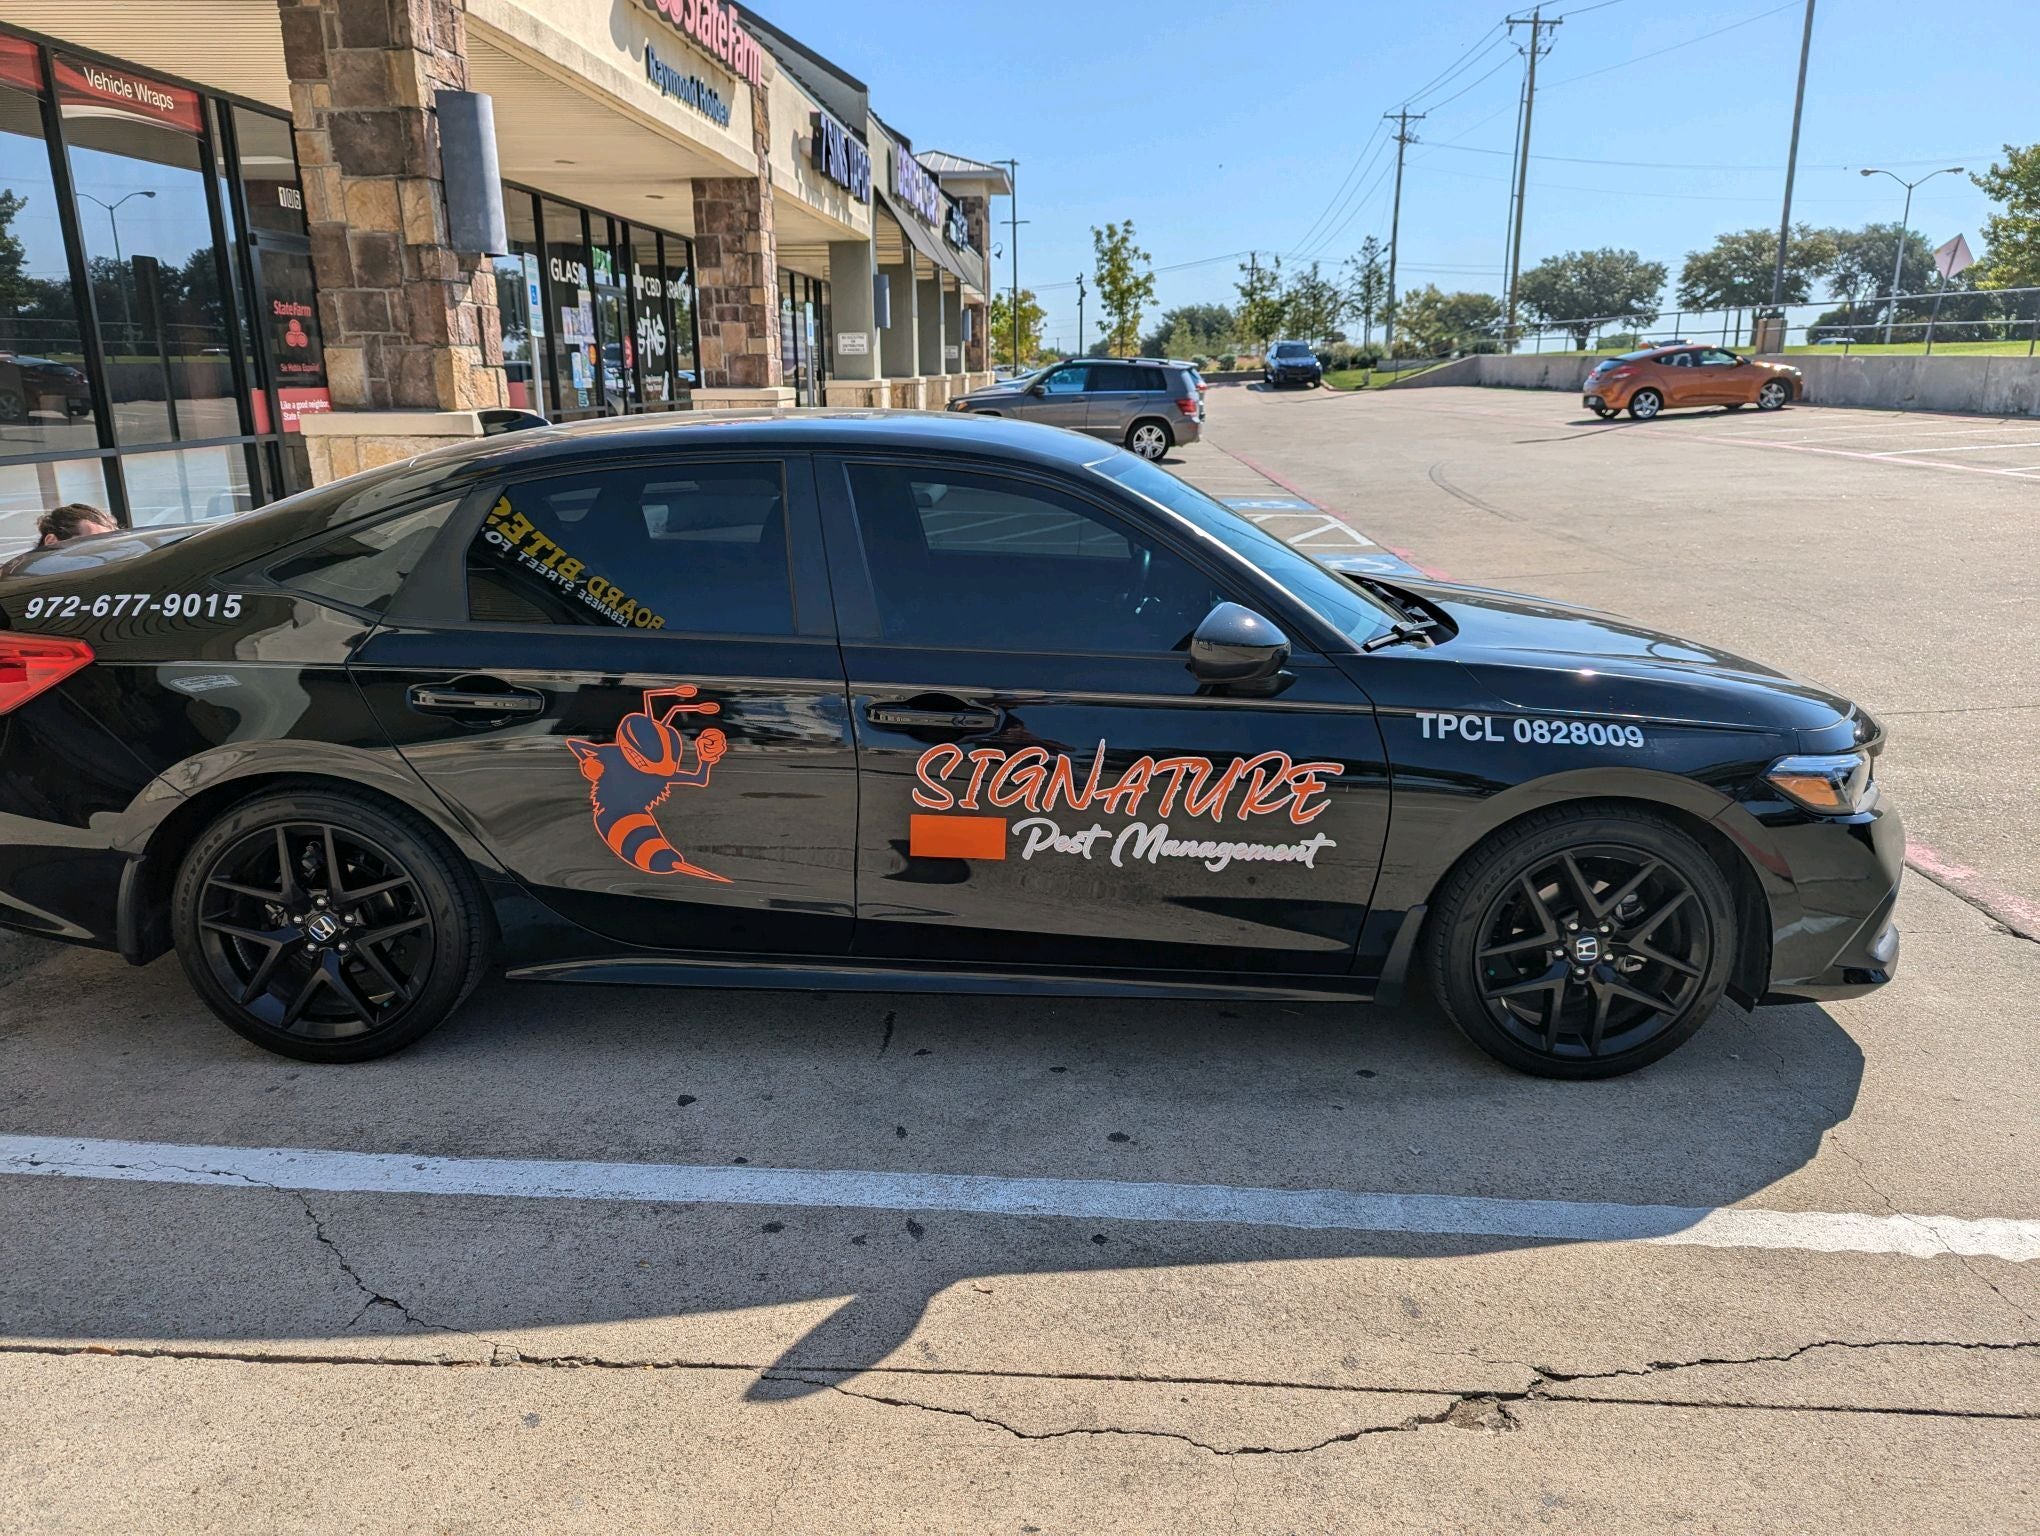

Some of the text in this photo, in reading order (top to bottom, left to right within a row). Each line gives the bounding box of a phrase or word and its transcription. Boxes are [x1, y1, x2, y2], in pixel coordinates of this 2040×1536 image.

[83, 66, 174, 112] Vehicle Wraps
[648, 45, 730, 128] Raymond Holder
[278, 186, 301, 209] 106
[645, 276, 662, 297] CBD
[280, 400, 292, 410] Like
[296, 400, 308, 412] good
[24, 593, 243, 620] 972-677-9015
[1416, 712, 1645, 748] TPCL 0828009
[911, 738, 1345, 825] SIGNATURE
[1011, 817, 1337, 873] Pest Management
